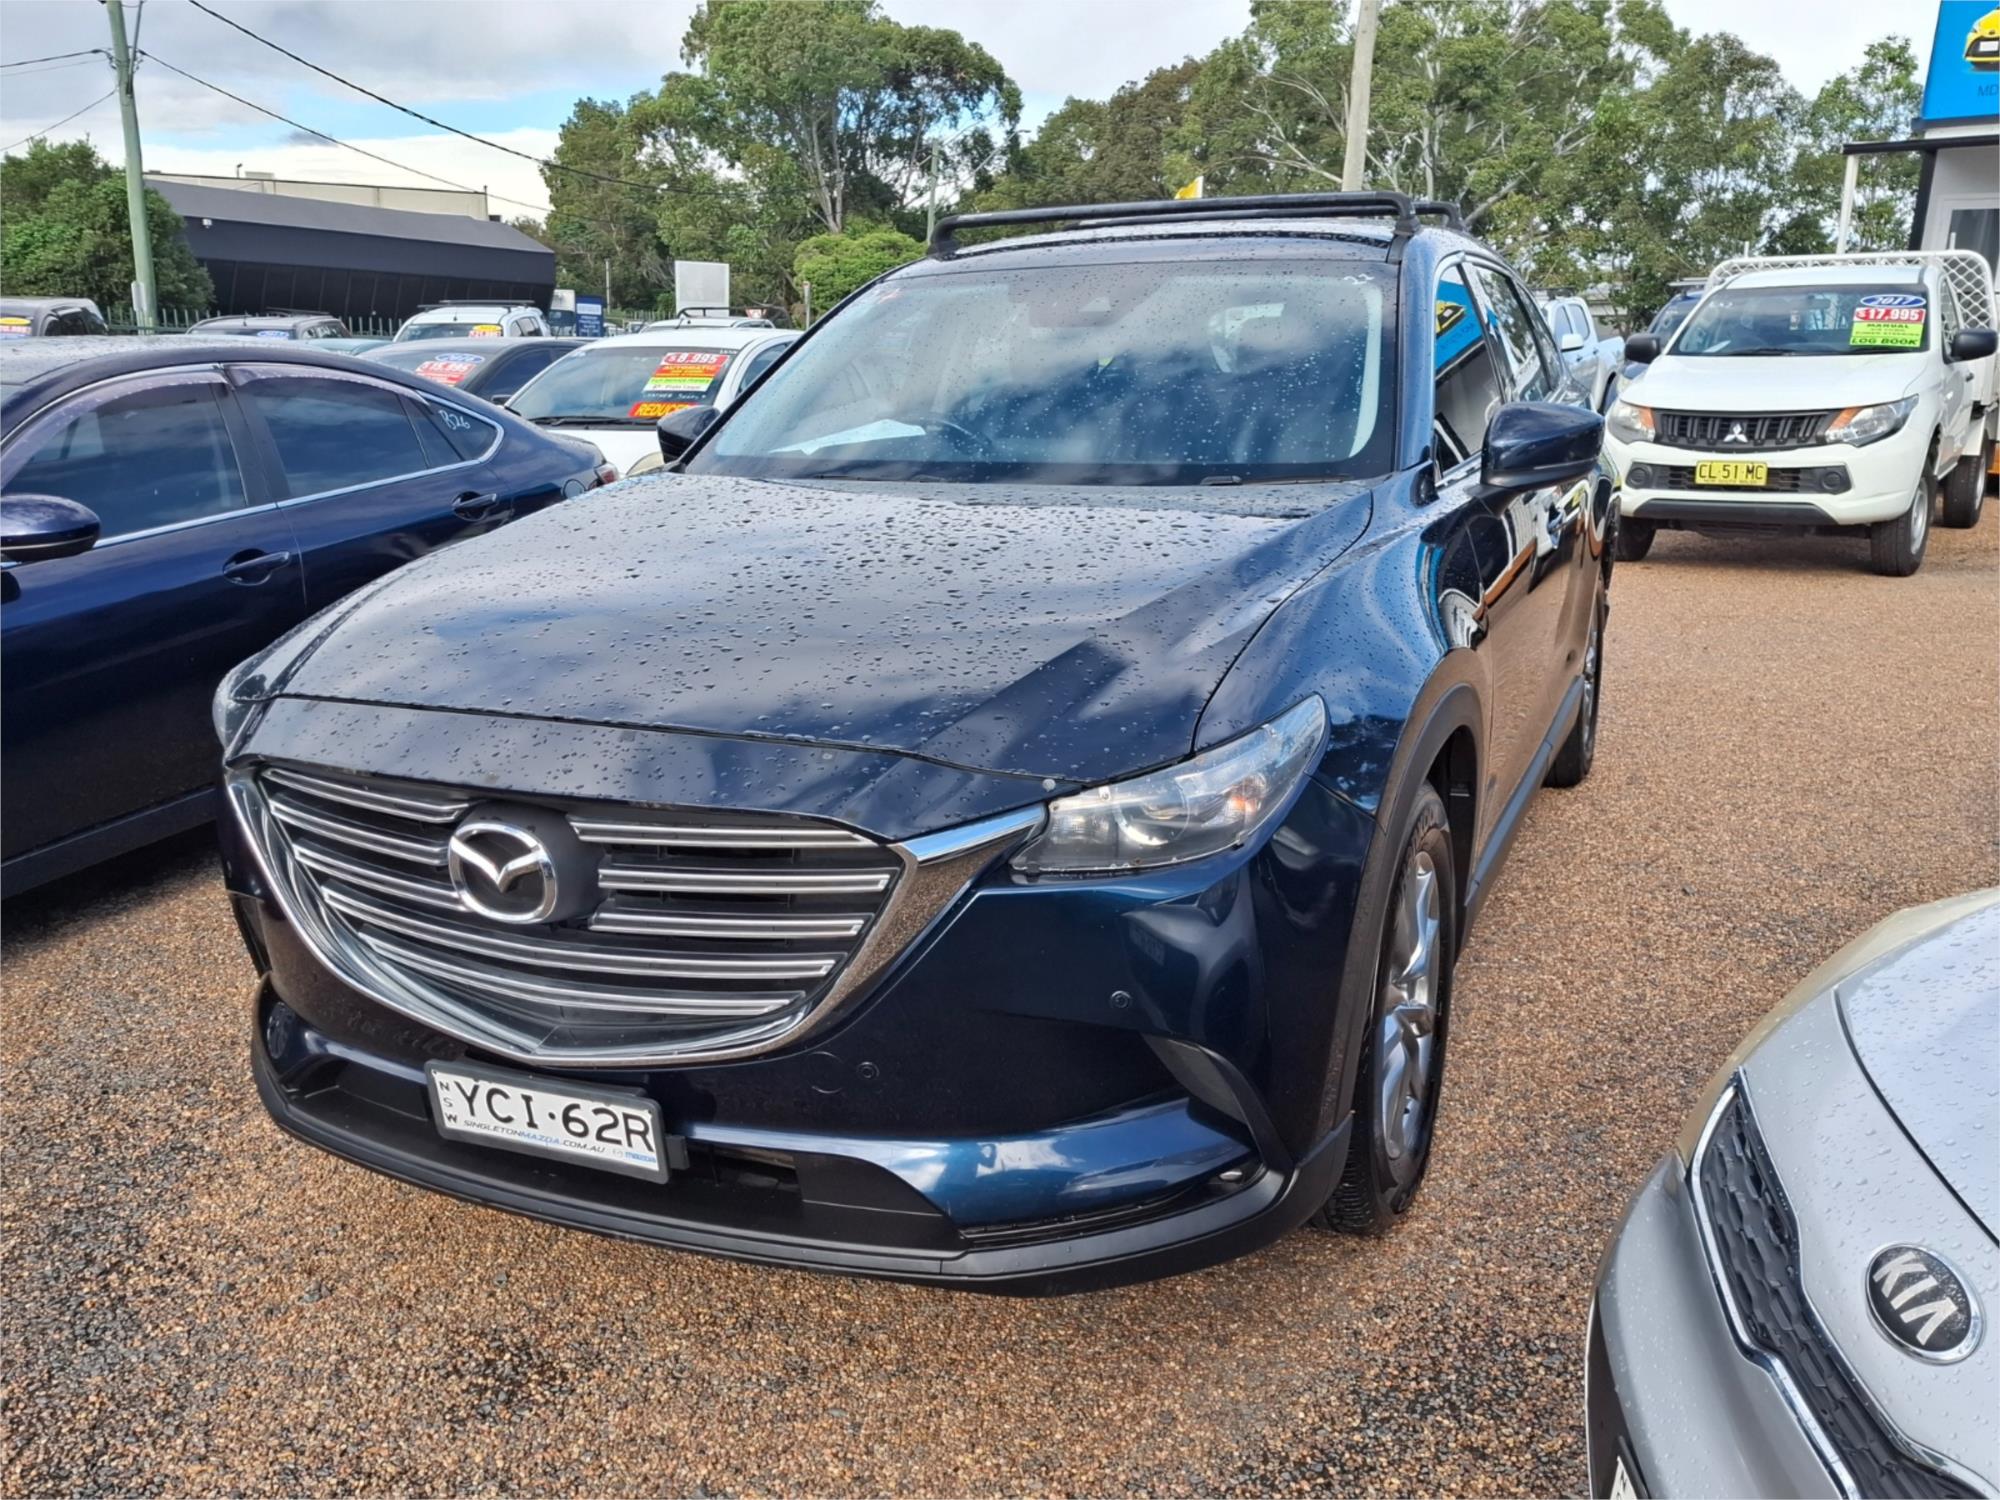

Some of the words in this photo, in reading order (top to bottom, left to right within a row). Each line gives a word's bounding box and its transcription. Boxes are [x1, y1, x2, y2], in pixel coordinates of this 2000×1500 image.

[1871, 296, 1913, 305] 2017
[1857, 309, 1920, 320] $17,995
[1852, 337, 1877, 345] LOG
[1872, 1251, 1958, 1346] KIA
